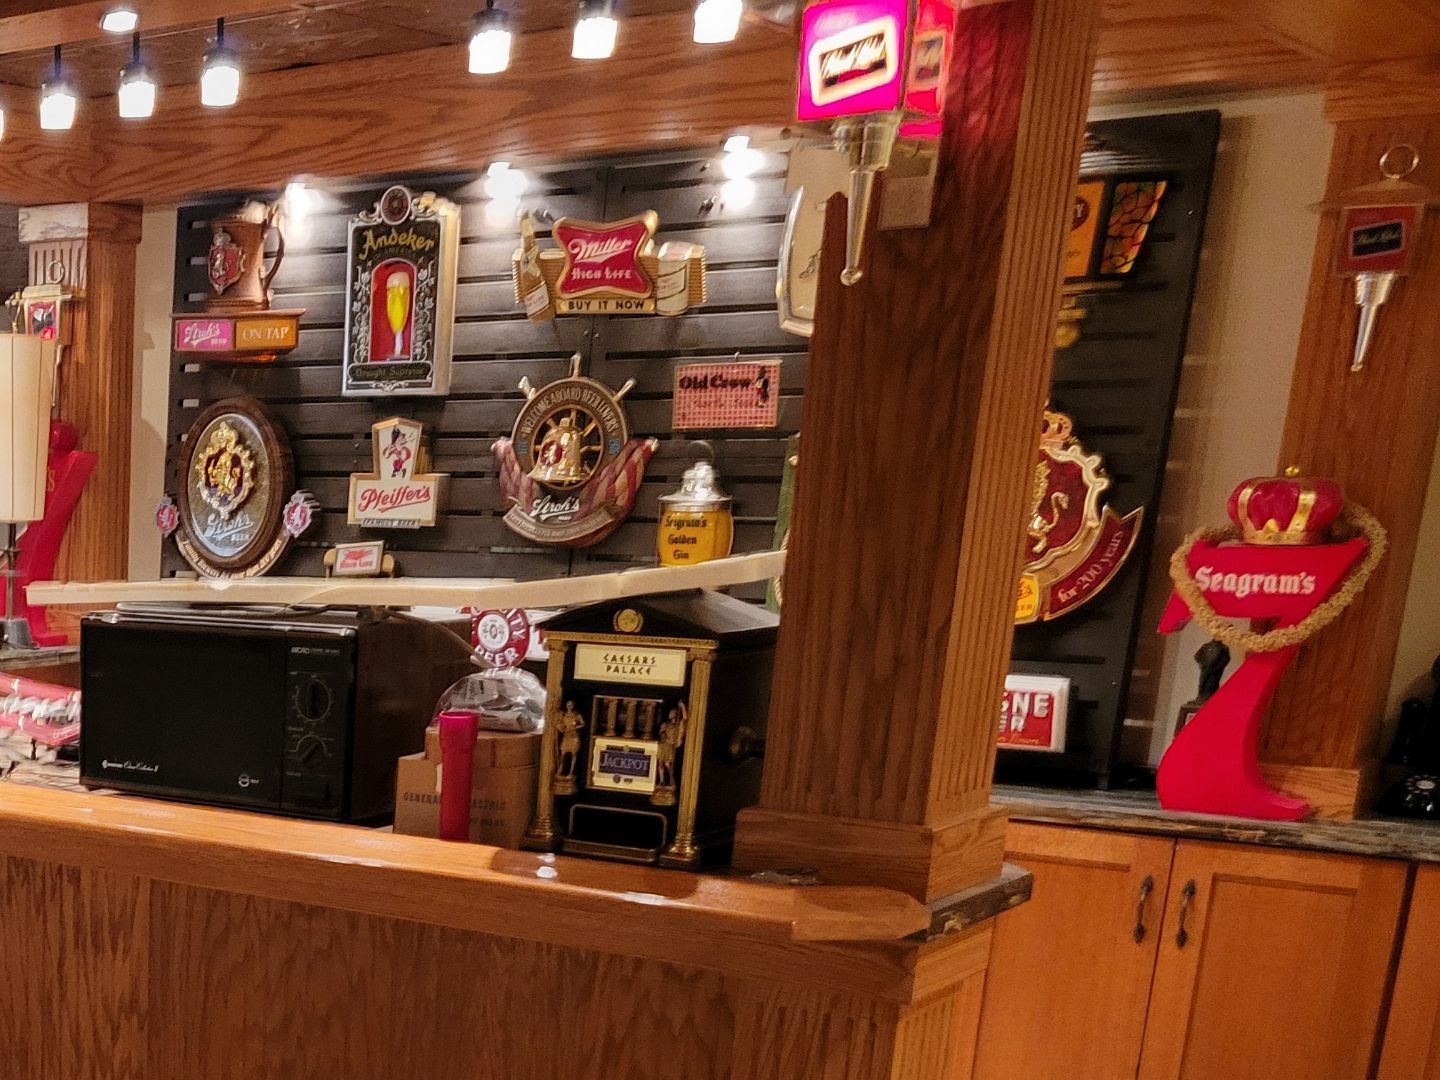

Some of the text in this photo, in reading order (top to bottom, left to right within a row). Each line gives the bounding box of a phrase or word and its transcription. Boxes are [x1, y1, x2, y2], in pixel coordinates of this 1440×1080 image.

[359, 227, 435, 260] Andeker
[568, 238, 634, 262] Miller
[571, 266, 601, 281] HIGH
[568, 300, 645, 311] BUY IT NOW
[184, 322, 290, 347] Stroh's ON TAP
[679, 373, 753, 390] Old Crow
[520, 387, 620, 434] WELCOME ABOARD BEER LOVERS
[358, 485, 431, 513] Pfeiffer's
[529, 494, 580, 517] Stroh's
[667, 533, 697, 545] Golden
[672, 549, 689, 560] Gin
[1057, 530, 1124, 603] for 200 years
[1195, 566, 1316, 598] Seagram's
[603, 653, 657, 665] CAESARS
[606, 664, 652, 676] PALACE
[600, 752, 649, 771] JACKPOT
[403, 791, 439, 805] GENERA
